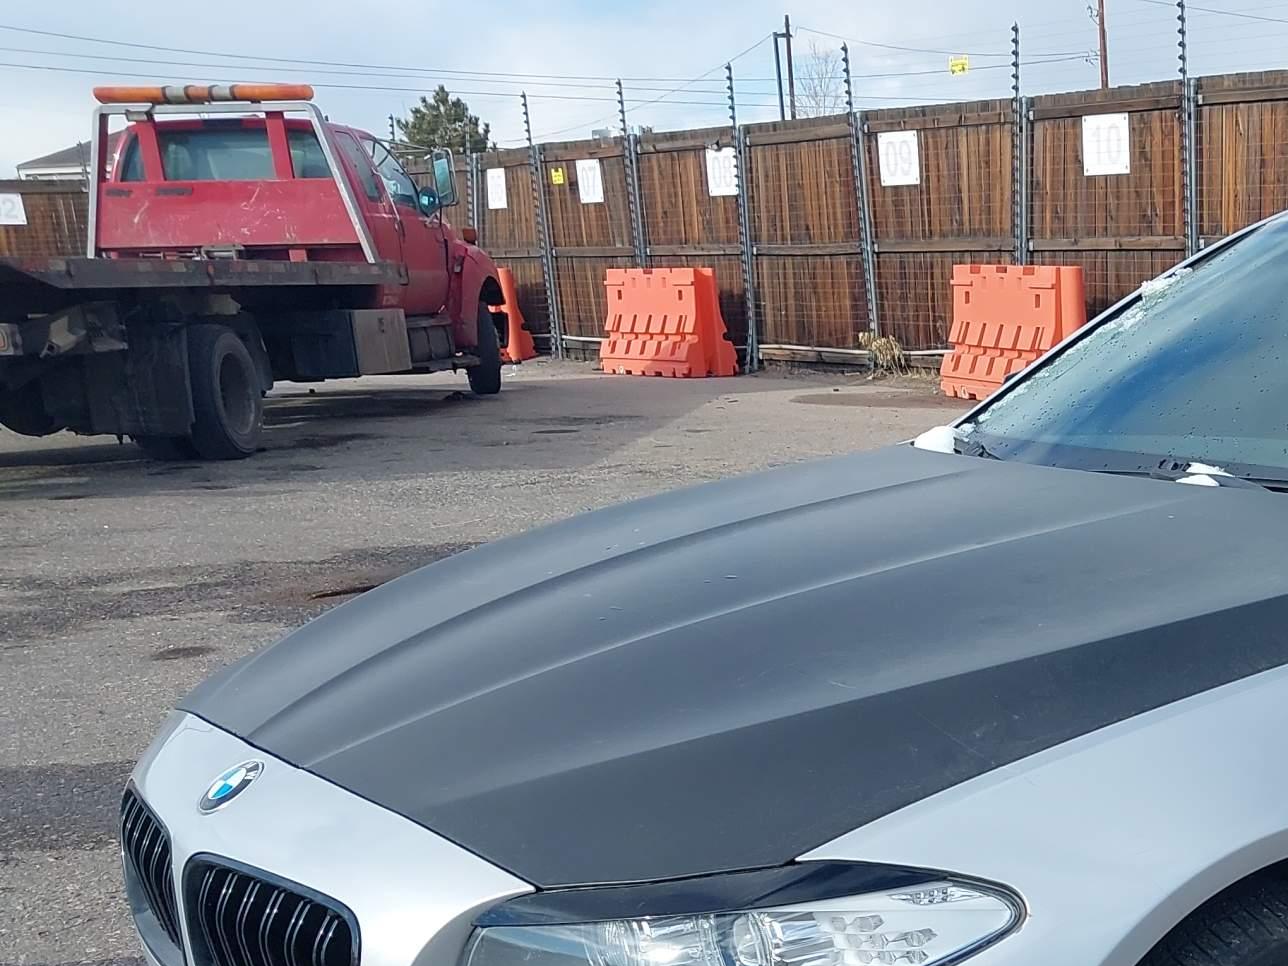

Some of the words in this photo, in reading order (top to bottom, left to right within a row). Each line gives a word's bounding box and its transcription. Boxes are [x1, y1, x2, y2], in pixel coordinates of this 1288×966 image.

[886, 140, 912, 176] 09
[1091, 123, 1121, 165] 10
[581, 166, 598, 197] 07
[712, 156, 732, 188] 08
